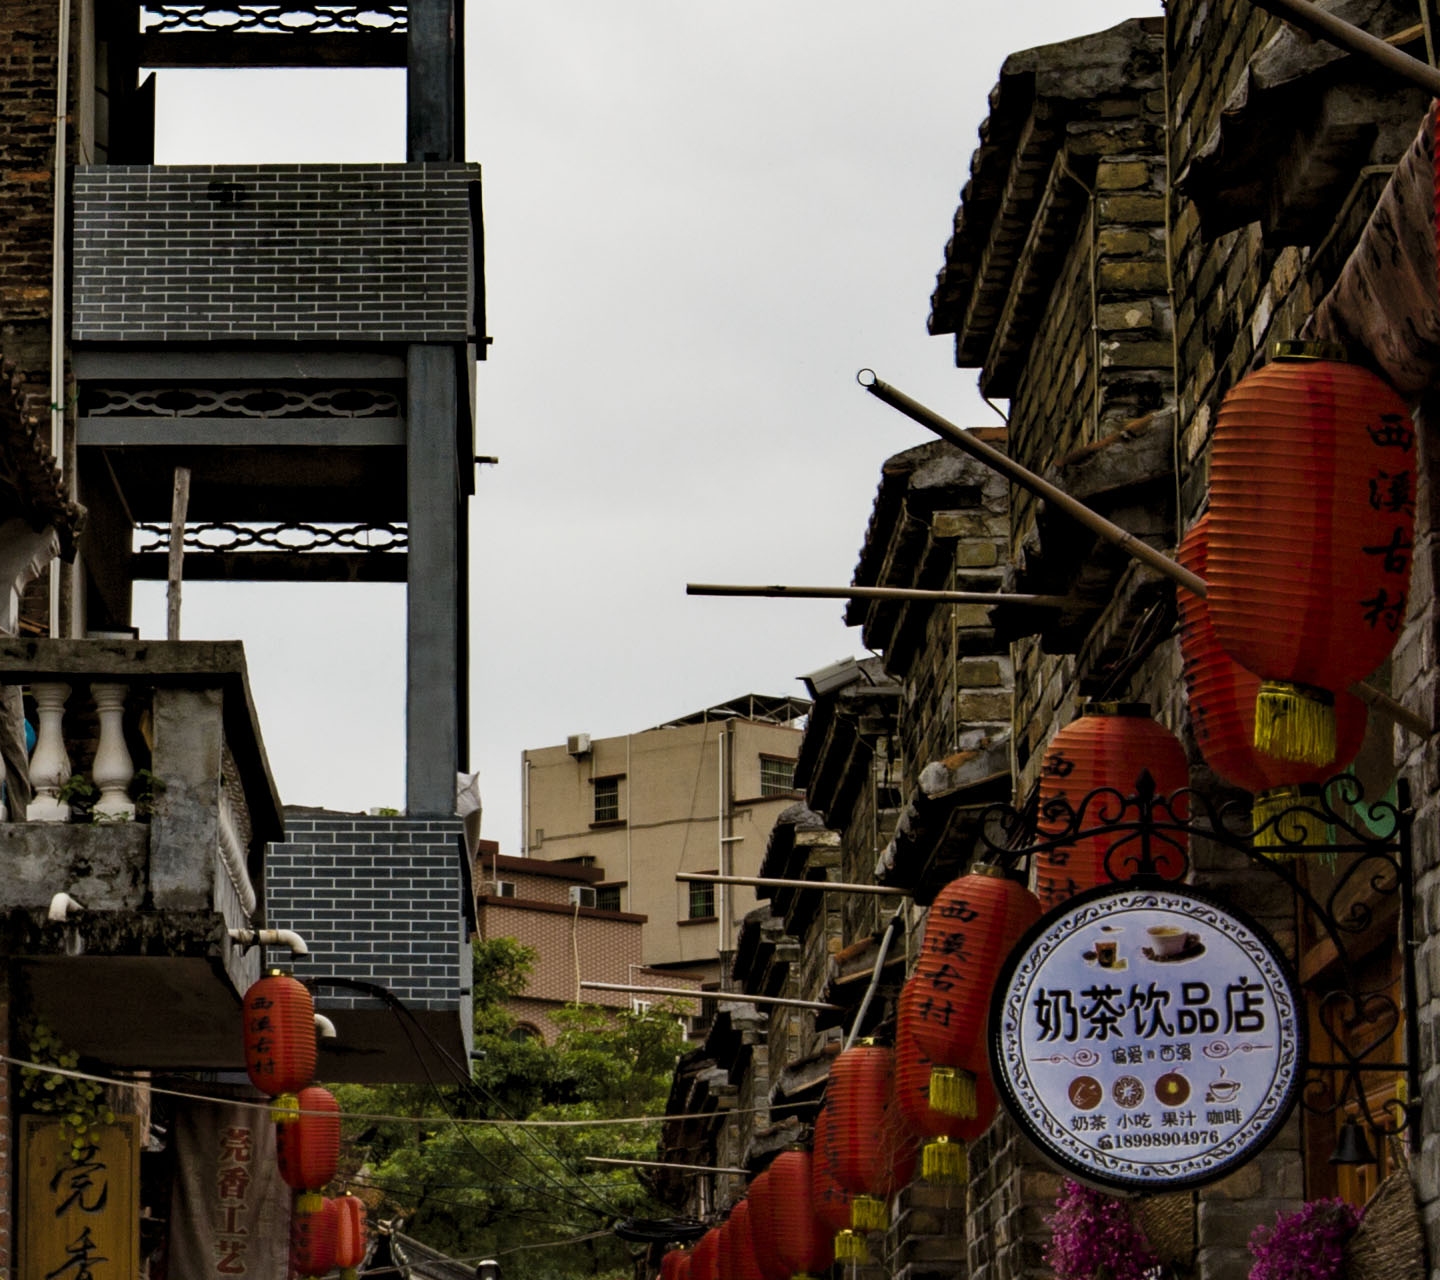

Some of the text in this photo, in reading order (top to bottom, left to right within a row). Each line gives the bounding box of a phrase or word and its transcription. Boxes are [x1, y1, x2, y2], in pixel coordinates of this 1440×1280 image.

[1360, 414, 1416, 633] 西溪古村
[919, 899, 979, 1027] 西溪古村
[1033, 976, 1265, 1042] 奶茶饮品店
[1071, 1108, 1242, 1131] 奶茶 小吃 果汁 咖啡
[1114, 1130, 1220, 1149] 18998904976
[214, 1127, 253, 1275] 莞香工艺
